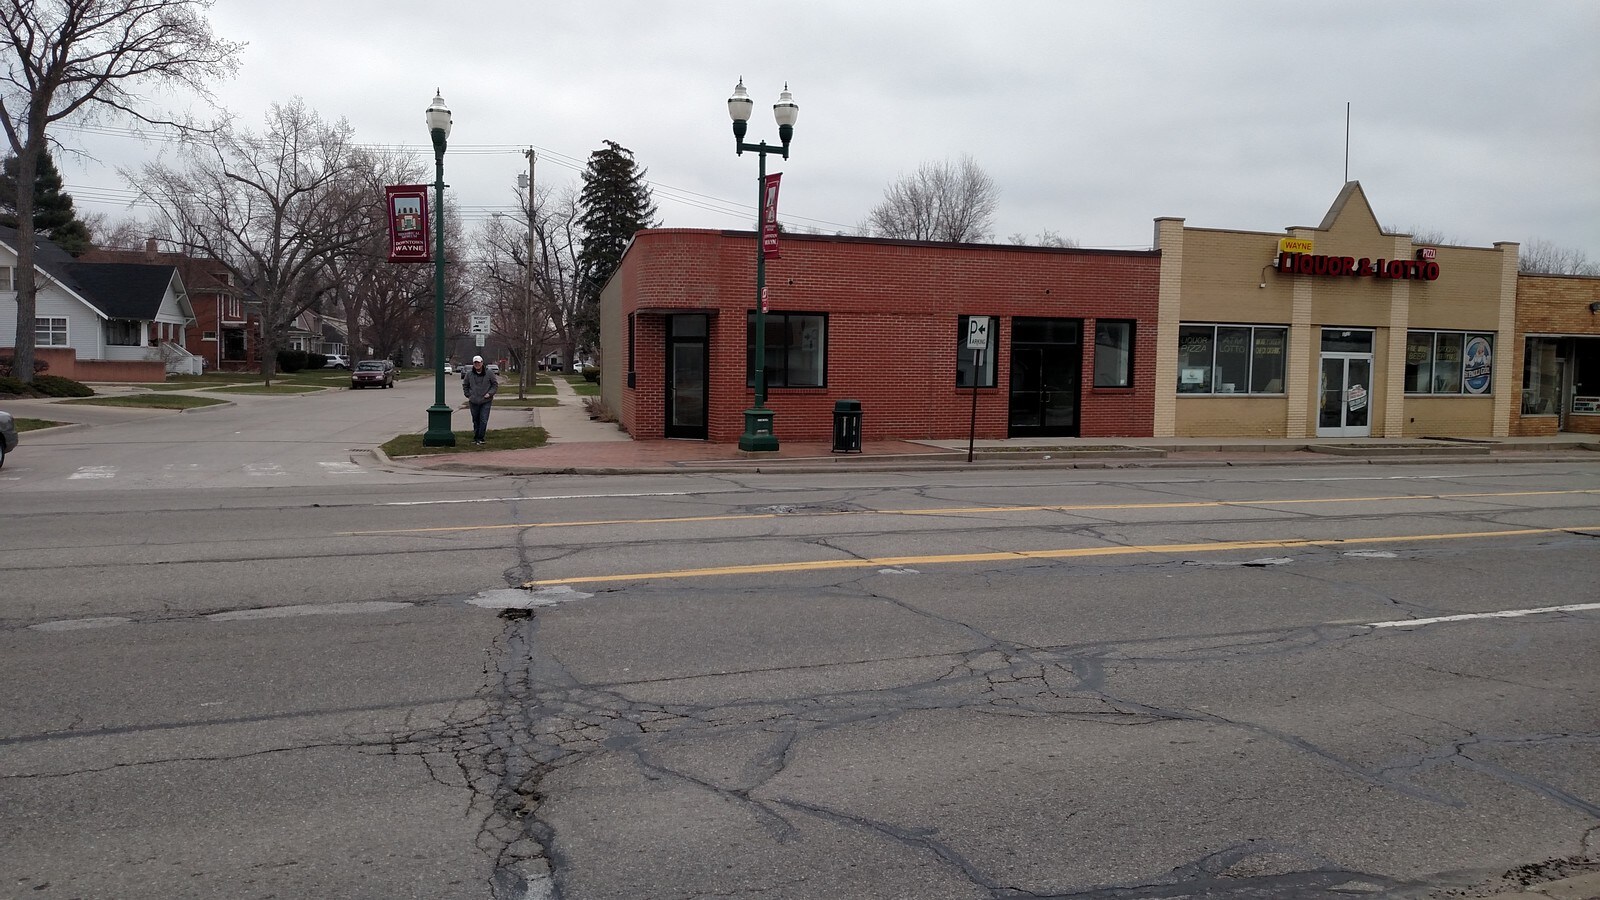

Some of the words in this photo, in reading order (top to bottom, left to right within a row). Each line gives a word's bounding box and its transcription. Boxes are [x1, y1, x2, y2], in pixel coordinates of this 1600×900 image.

[1285, 241, 1312, 251] WAYNE
[1422, 248, 1437, 259] PIZZA
[1280, 252, 1355, 277] LIQUOR
[1357, 257, 1373, 277] &
[1376, 258, 1440, 281] LOTTO
[1181, 336, 1208, 344] LIQUOR
[1181, 344, 1207, 353] PIZZA
[1219, 345, 1246, 353] LOTTO
[1408, 352, 1426, 360] BEER
